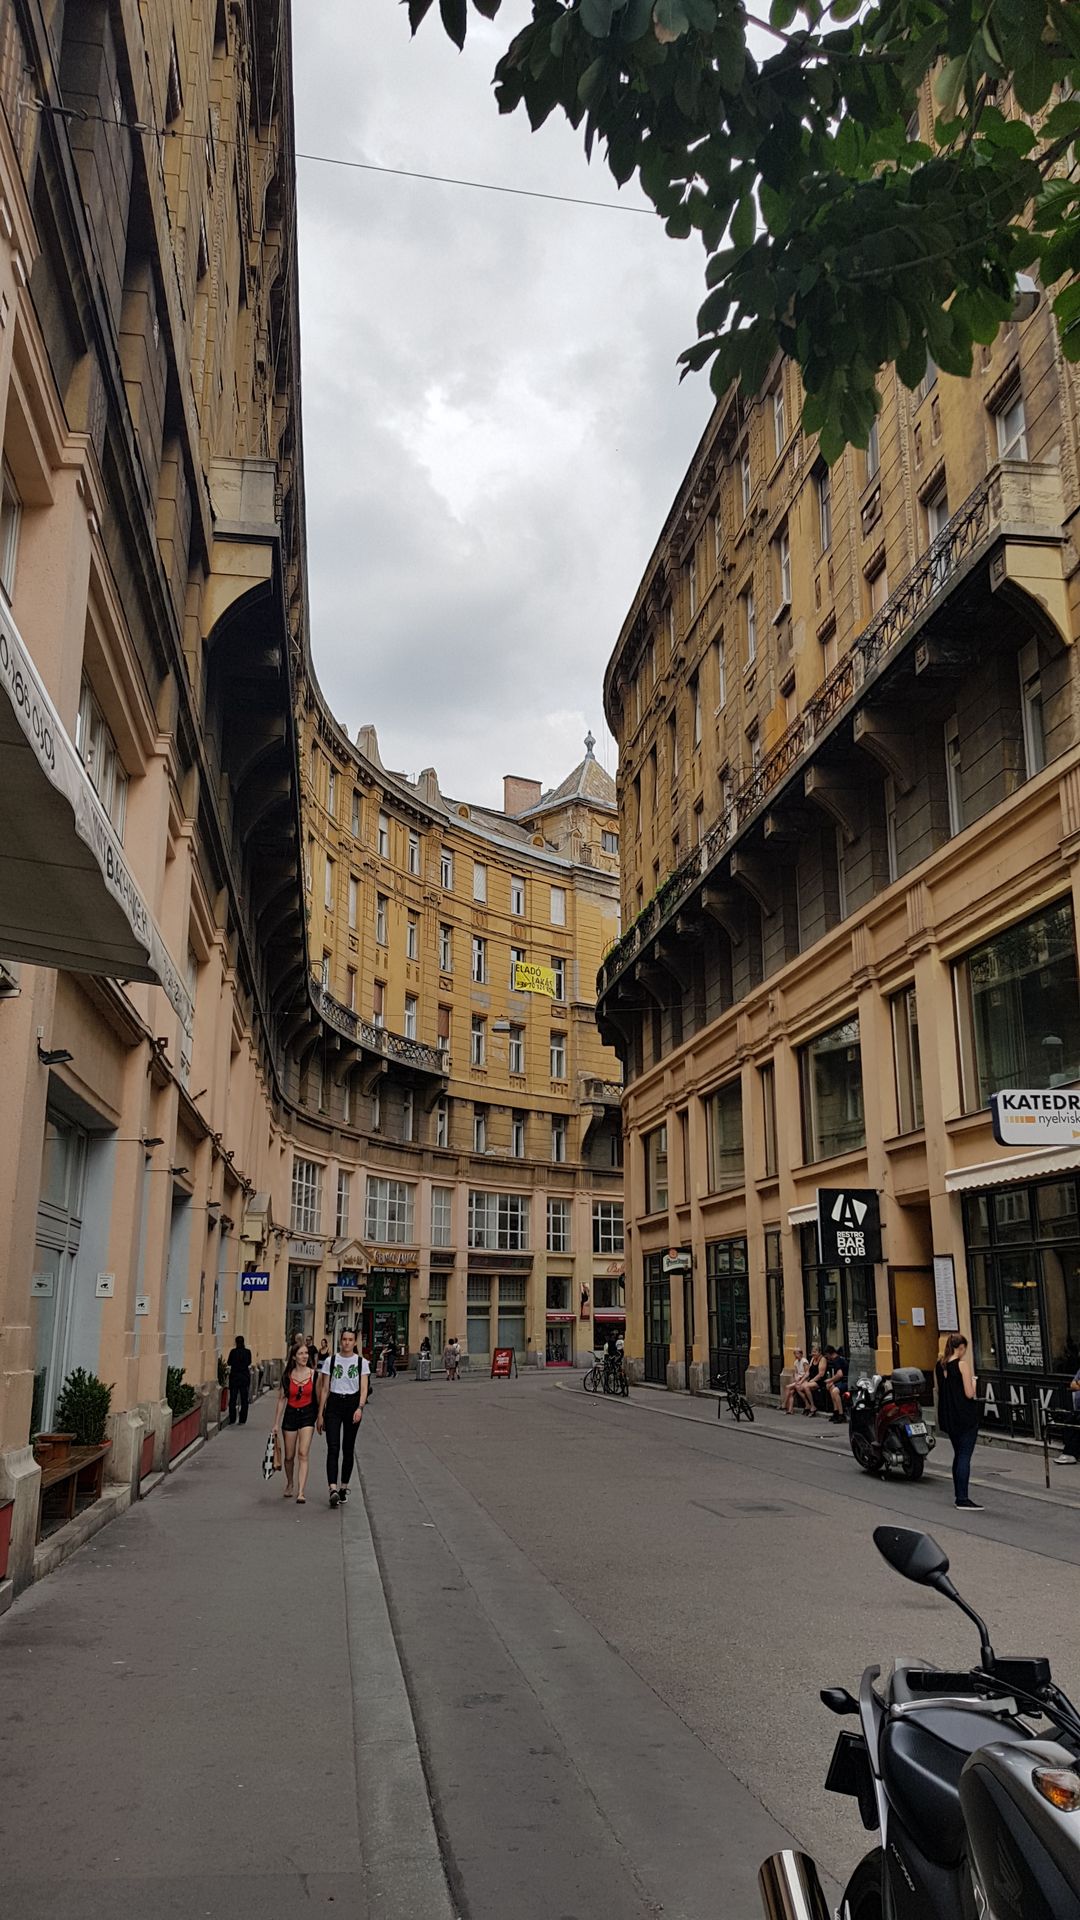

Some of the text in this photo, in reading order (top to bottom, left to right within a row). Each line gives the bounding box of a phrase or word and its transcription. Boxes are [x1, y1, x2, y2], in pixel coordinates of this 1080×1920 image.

[516, 964, 541, 977] ELADÓ
[1002, 1094, 1080, 1110] KATEDR
[837, 1237, 865, 1248] BAR
[838, 1247, 866, 1256] CLUB
[243, 1277, 268, 1285] ATM
[1006, 1343, 1030, 1356] RESTRO
[1007, 1356, 1044, 1367] WINES SPIRITS
